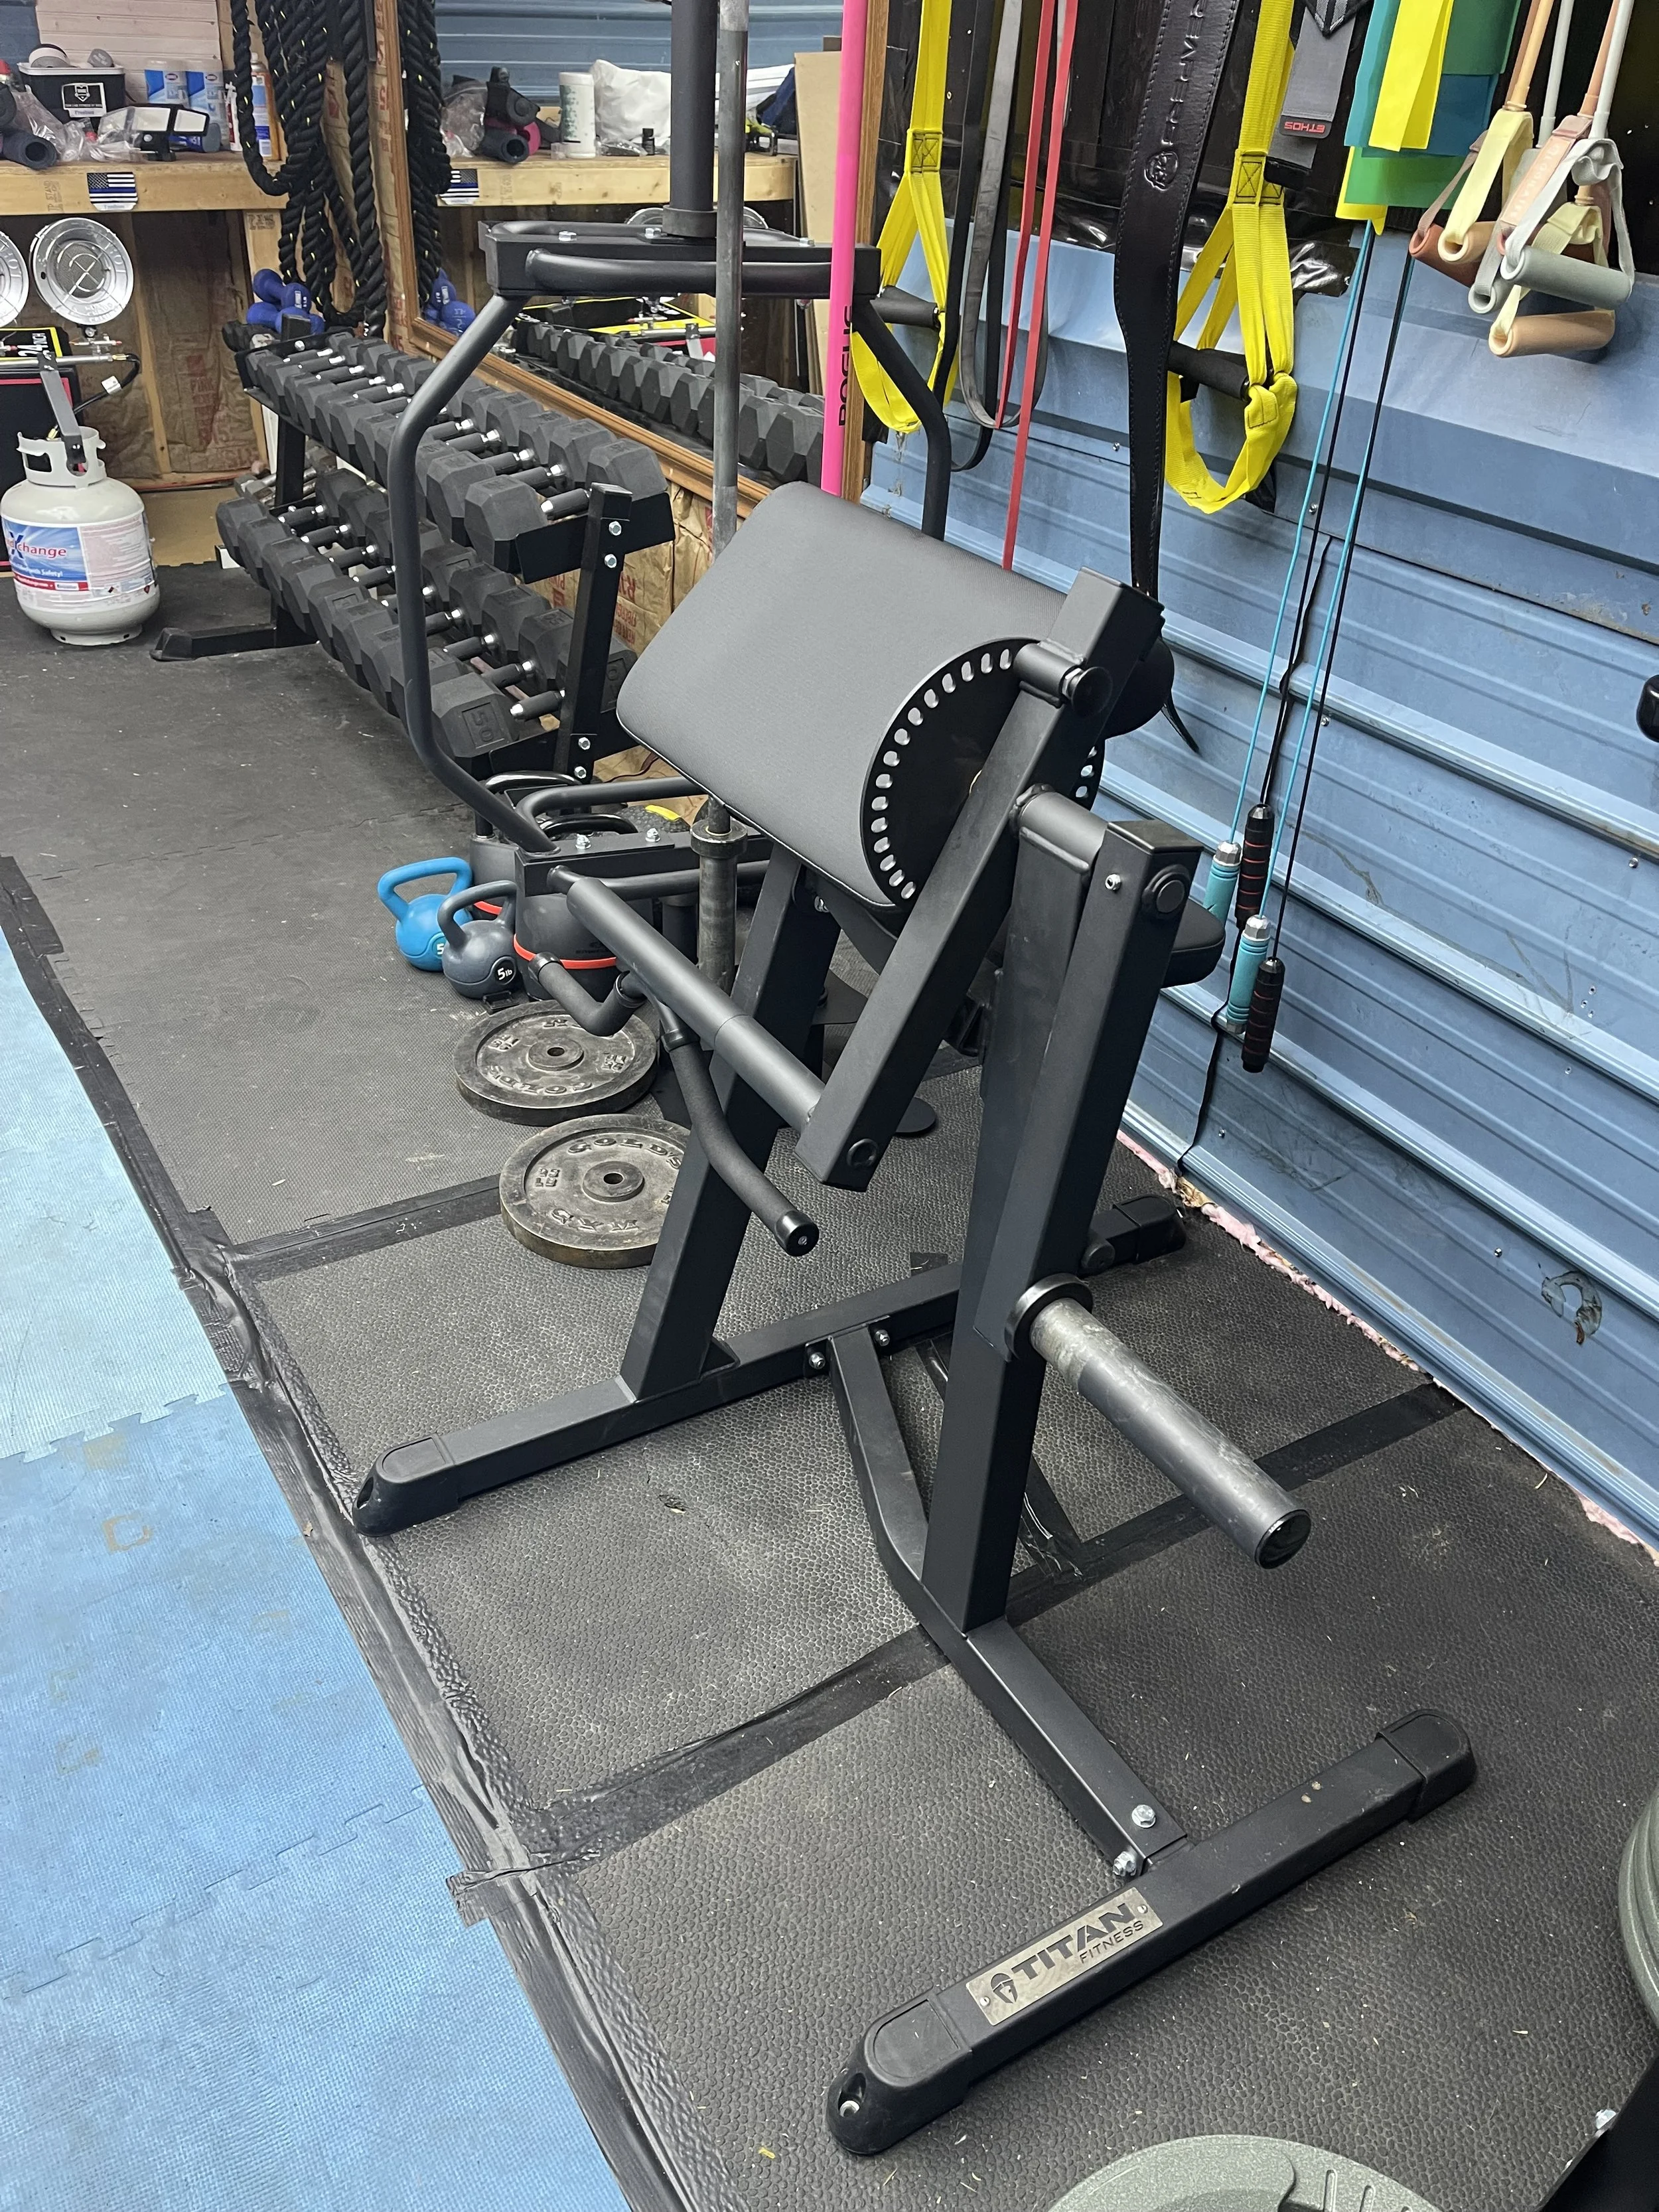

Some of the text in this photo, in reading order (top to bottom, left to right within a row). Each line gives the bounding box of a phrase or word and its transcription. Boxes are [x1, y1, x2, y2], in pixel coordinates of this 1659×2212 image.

[1284, 121, 1325, 133] ETHOS
[32, 332, 48, 344] INCH
[471, 711, 494, 743] 50
[497, 968, 513, 980] 5lb
[486, 1065, 593, 1094] GOLD'S
[568, 1138, 682, 1169] GOLD'S
[551, 1208, 639, 1231] GYM
[1011, 1902, 1135, 1980] TITAN
[1079, 1919, 1144, 1964] FITNESS
